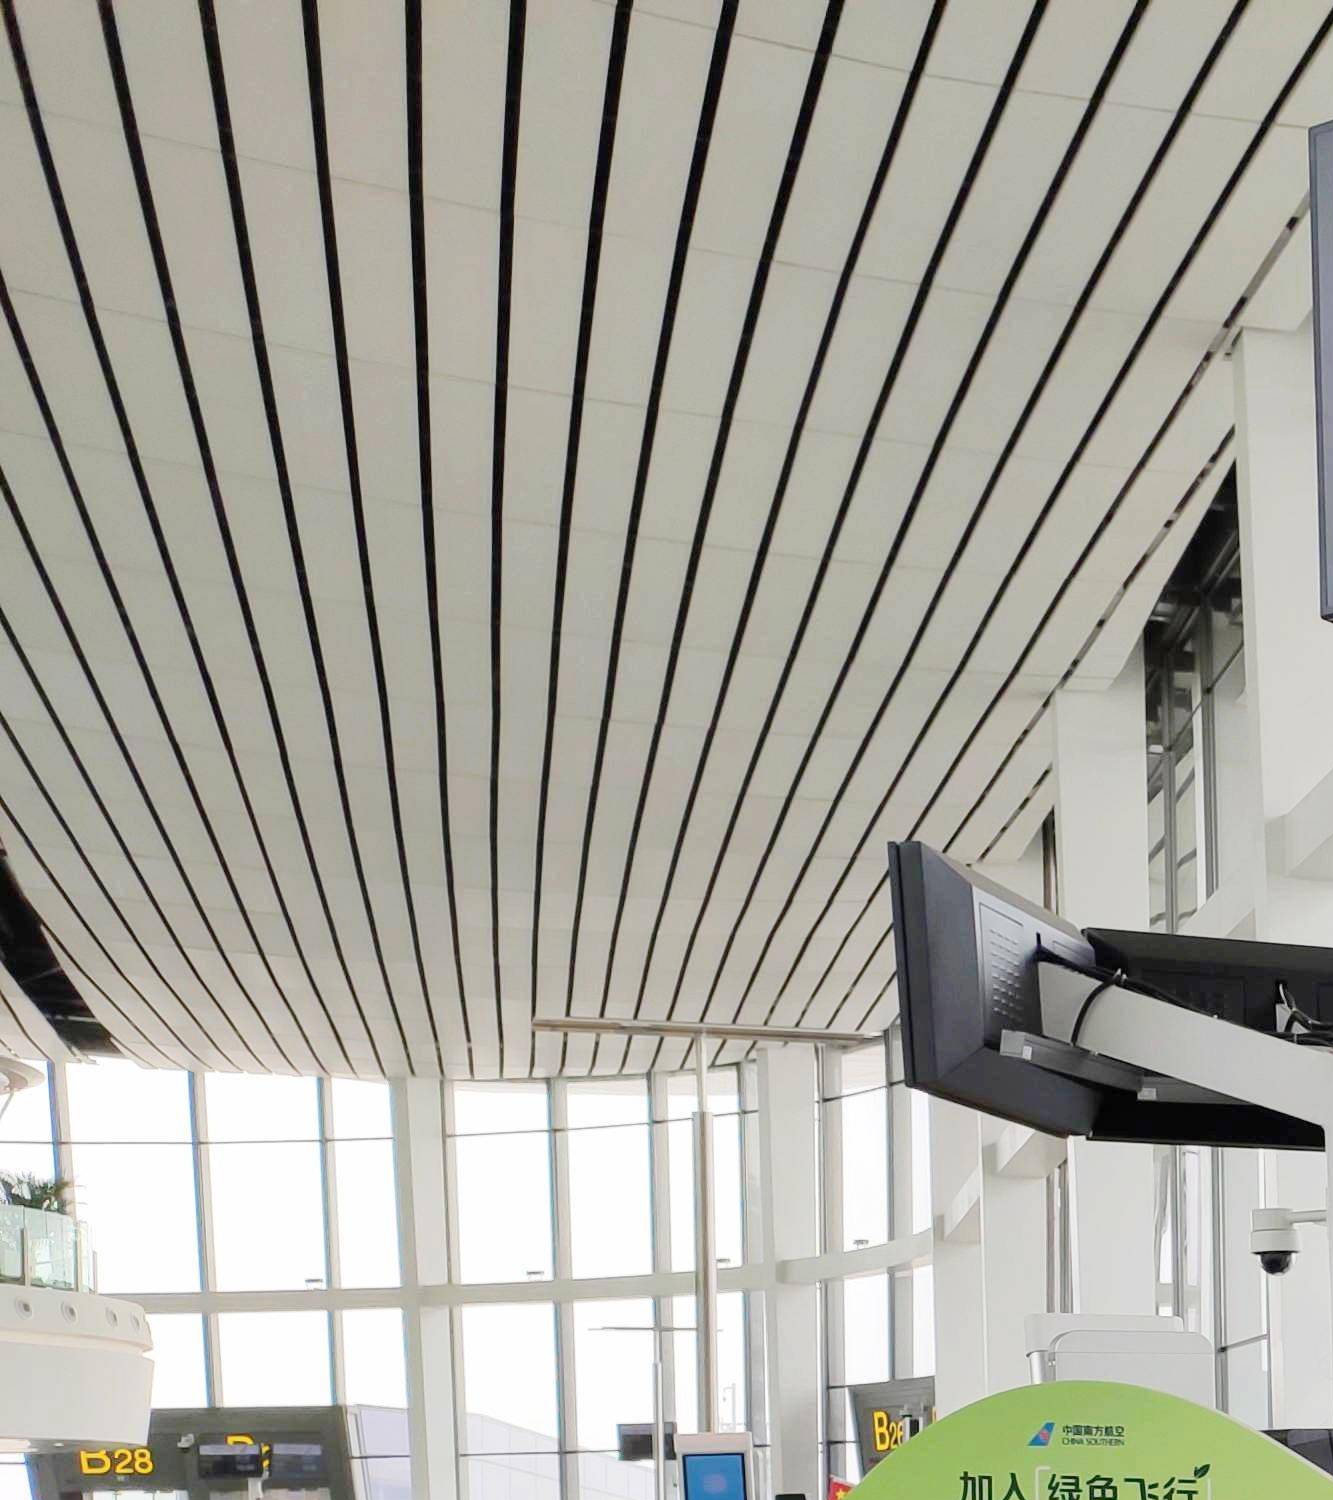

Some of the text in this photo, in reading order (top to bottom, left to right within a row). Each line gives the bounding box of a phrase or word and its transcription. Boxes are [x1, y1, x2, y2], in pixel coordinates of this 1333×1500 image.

[1062, 1425, 1125, 1437] 中国南方航空
[81, 1448, 155, 1474] B28
